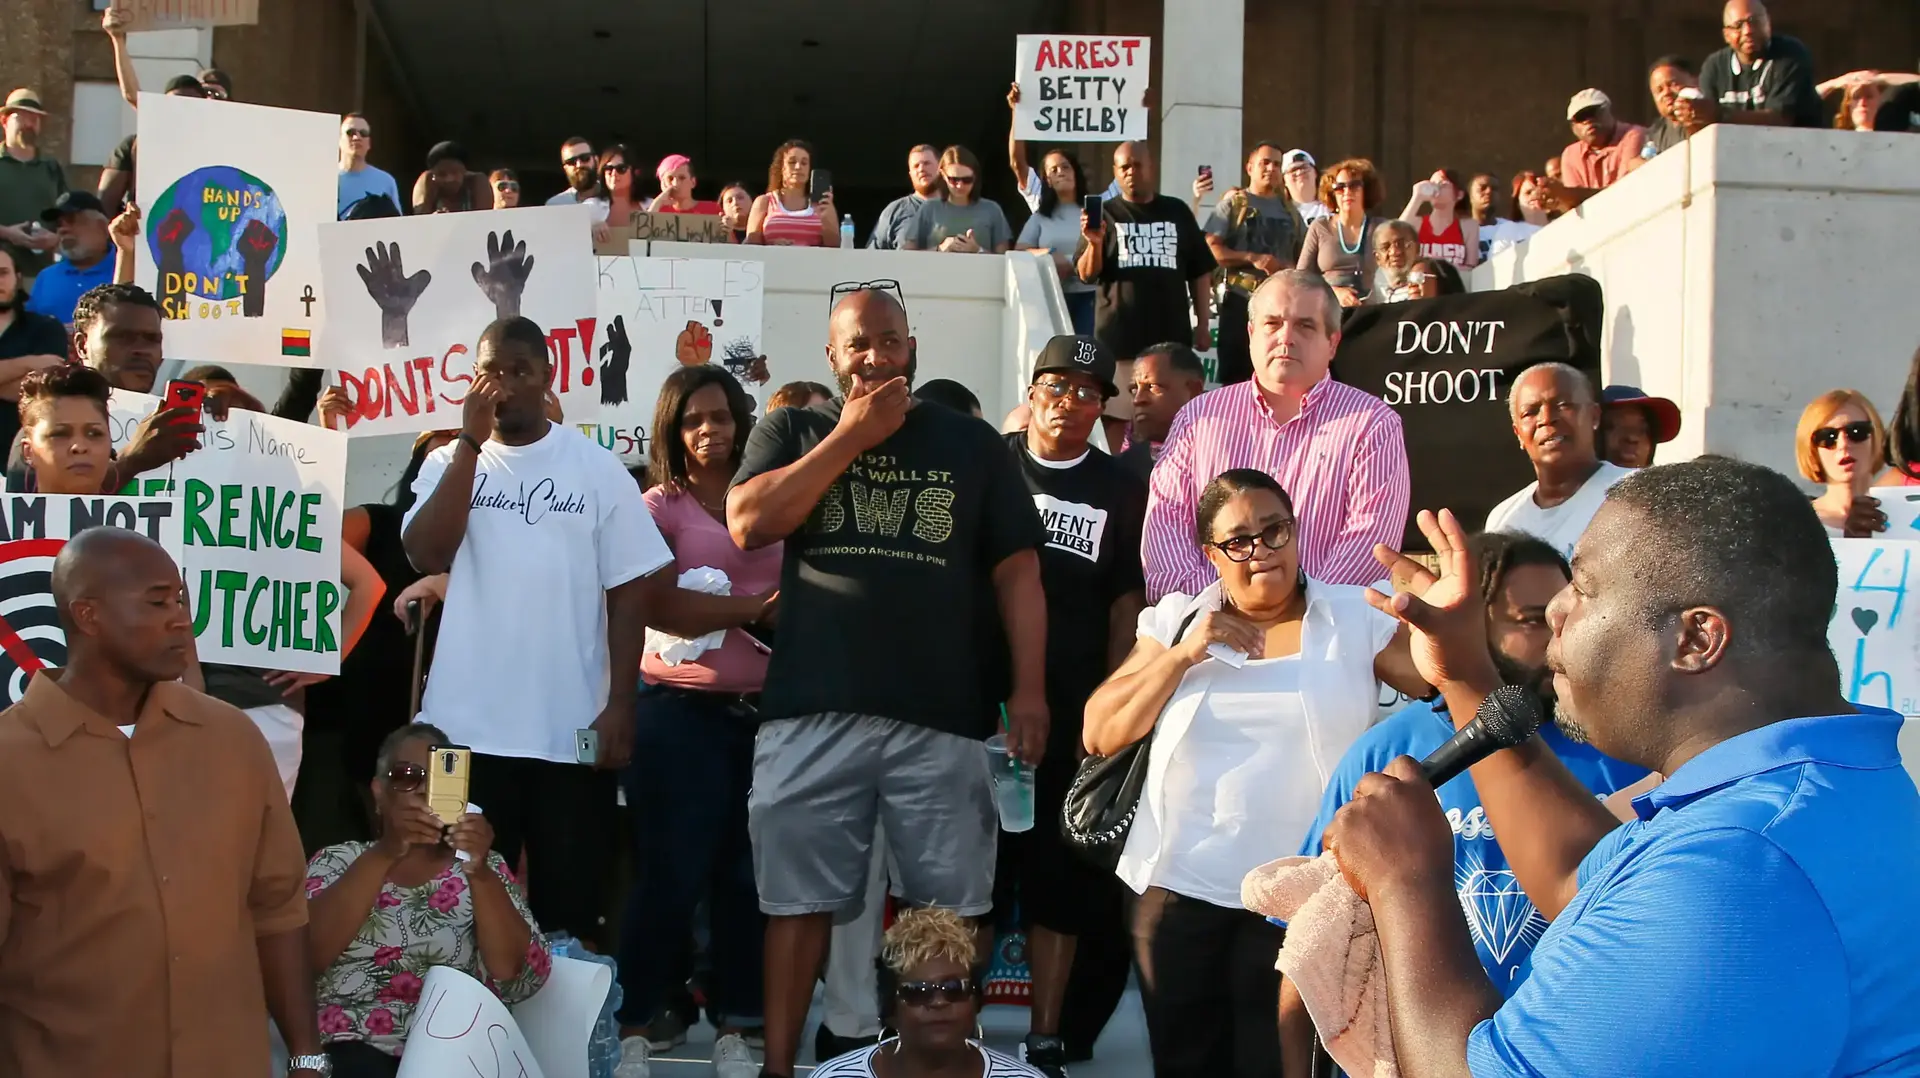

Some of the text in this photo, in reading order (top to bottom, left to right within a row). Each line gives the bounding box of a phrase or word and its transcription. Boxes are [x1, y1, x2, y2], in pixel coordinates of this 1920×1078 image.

[1034, 40, 1140, 71] ARREST
[1039, 75, 1126, 104] BETTY
[1034, 106, 1127, 134] SHELBY
[203, 187, 262, 208] HANDS
[218, 206, 241, 222] UP
[165, 272, 249, 295] DON'T
[162, 297, 241, 320] SHOOT
[1394, 320, 1505, 354] DON'T
[1383, 368, 1505, 405] SHOOT
[248, 418, 317, 465] Name
[868, 469, 922, 484] WALL
[927, 470, 955, 484] ST.
[69, 499, 172, 545] NOT
[1052, 532, 1090, 552] LIVES
[868, 546, 914, 560] ARCHER
[916, 553, 925, 561] &
[926, 555, 947, 567] PINE
